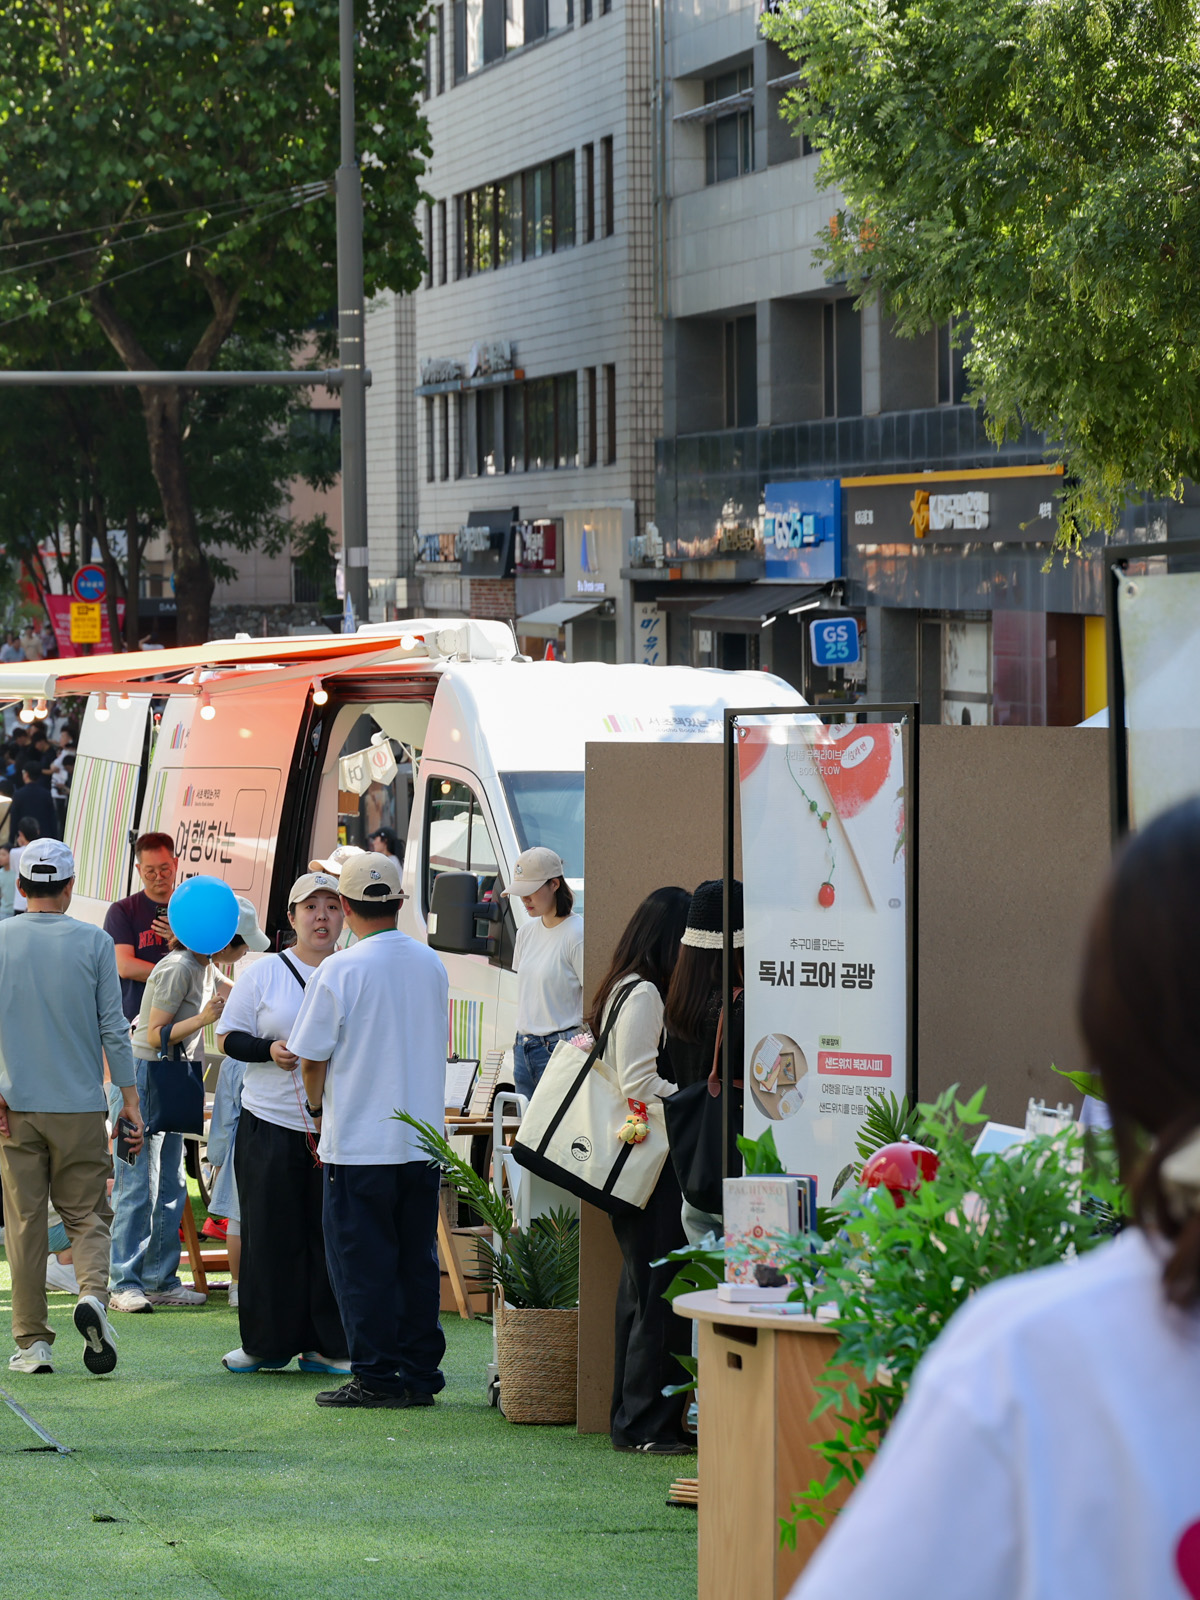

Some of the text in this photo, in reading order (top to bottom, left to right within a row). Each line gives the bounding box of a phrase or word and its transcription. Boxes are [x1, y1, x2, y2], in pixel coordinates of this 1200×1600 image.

[823, 626, 848, 643] GS
[825, 642, 849, 659] 25
[799, 766, 840, 775] BOOK FLOW
[175, 819, 236, 863] 여행하는
[790, 938, 844, 951] 추구미를 만드는
[759, 961, 875, 989] 독서 코어 공방
[825, 1057, 883, 1071] 샌드위치 북레시피
[821, 1083, 840, 1095] 여행을
[842, 1085, 854, 1095] 떠날
[819, 1102, 850, 1114] 샌드위치를
